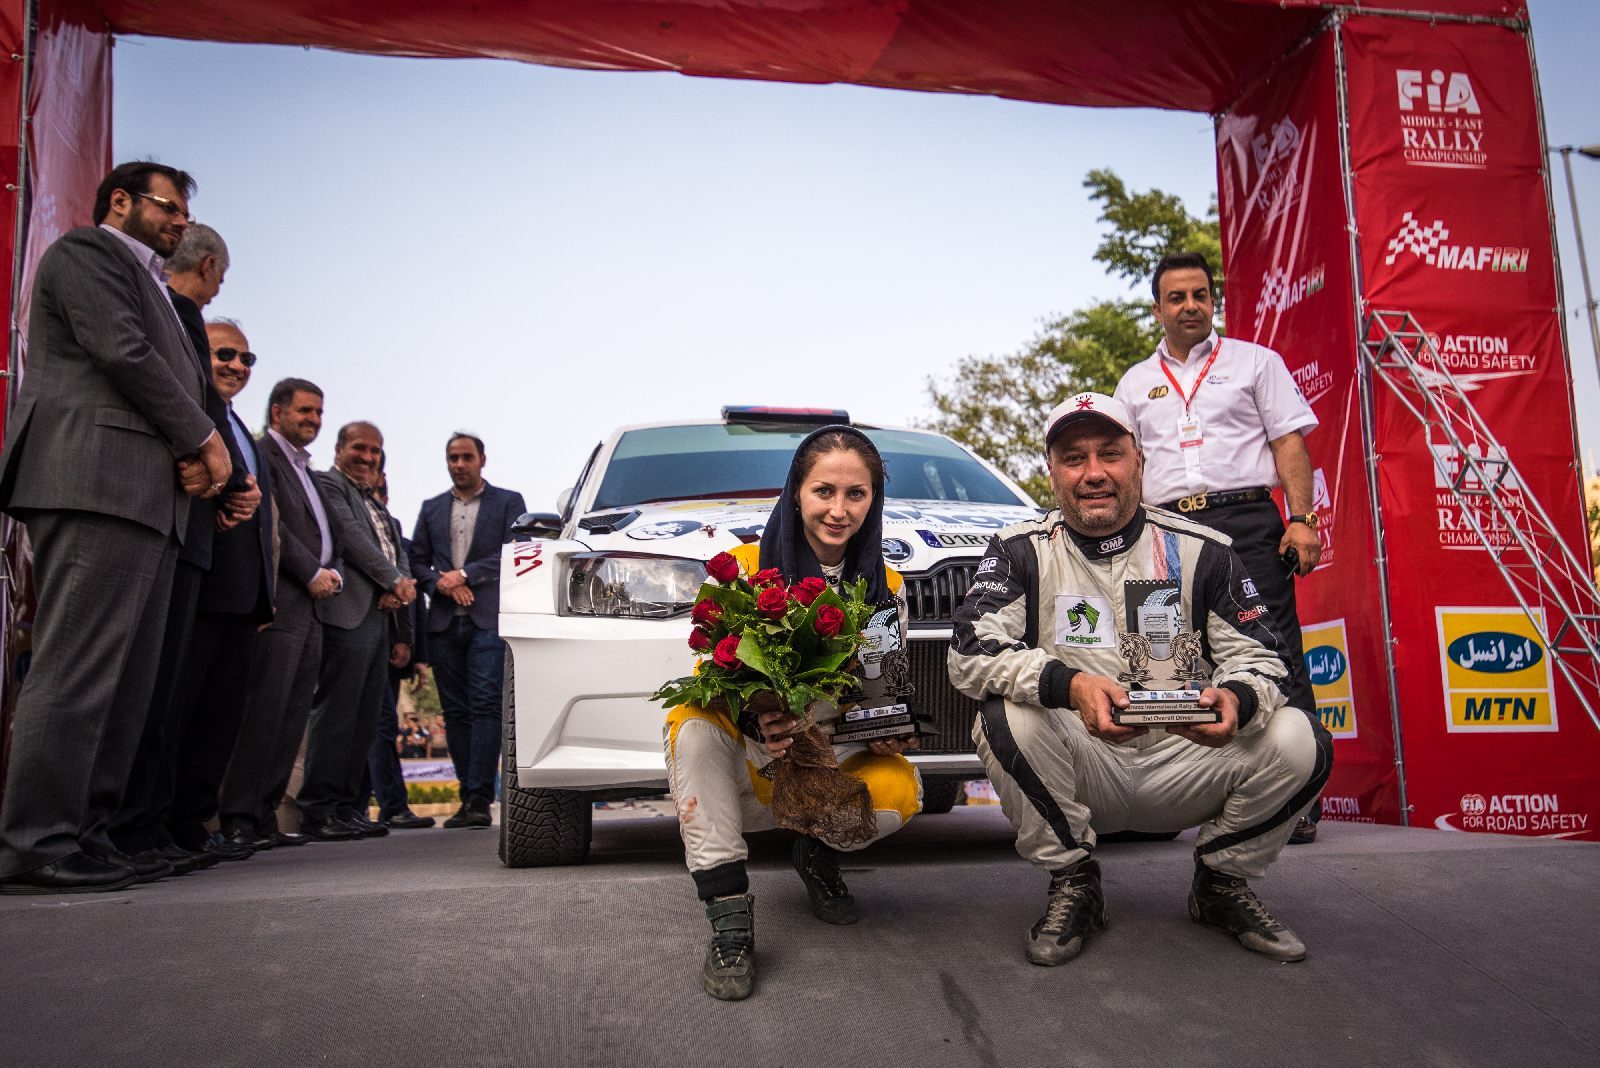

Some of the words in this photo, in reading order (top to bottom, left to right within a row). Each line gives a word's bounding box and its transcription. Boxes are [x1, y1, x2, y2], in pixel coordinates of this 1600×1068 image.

[1400, 115, 1446, 129] MIDDLE
[1455, 118, 1483, 131] EAST
[1402, 128, 1484, 152] RALLY
[1404, 149, 1488, 165] CHAMPIONSHIP
[1437, 246, 1530, 273] MAFIRI
[1443, 334, 1509, 355] ACTION
[1418, 350, 1440, 364] FO
[1440, 352, 1479, 369] ROAD
[1481, 354, 1536, 370] SAFETY
[1291, 360, 1319, 384] TION
[1305, 370, 1334, 397] SAFETY
[1436, 494, 1482, 507] MILE
[1491, 496, 1523, 508] AST
[1100, 537, 1124, 552] OMP
[1439, 531, 1521, 546] CHAMPONSHI
[1242, 580, 1258, 596] OM
[1065, 634, 1102, 645] racing21
[1178, 702, 1192, 710] Rally
[1464, 697, 1537, 721] MTN
[1322, 796, 1360, 815] ACTION
[1489, 793, 1559, 813] ACTION
[1462, 815, 1485, 828] FOR
[1486, 815, 1527, 830] ROAD
[1530, 813, 1588, 830] SAFETY
